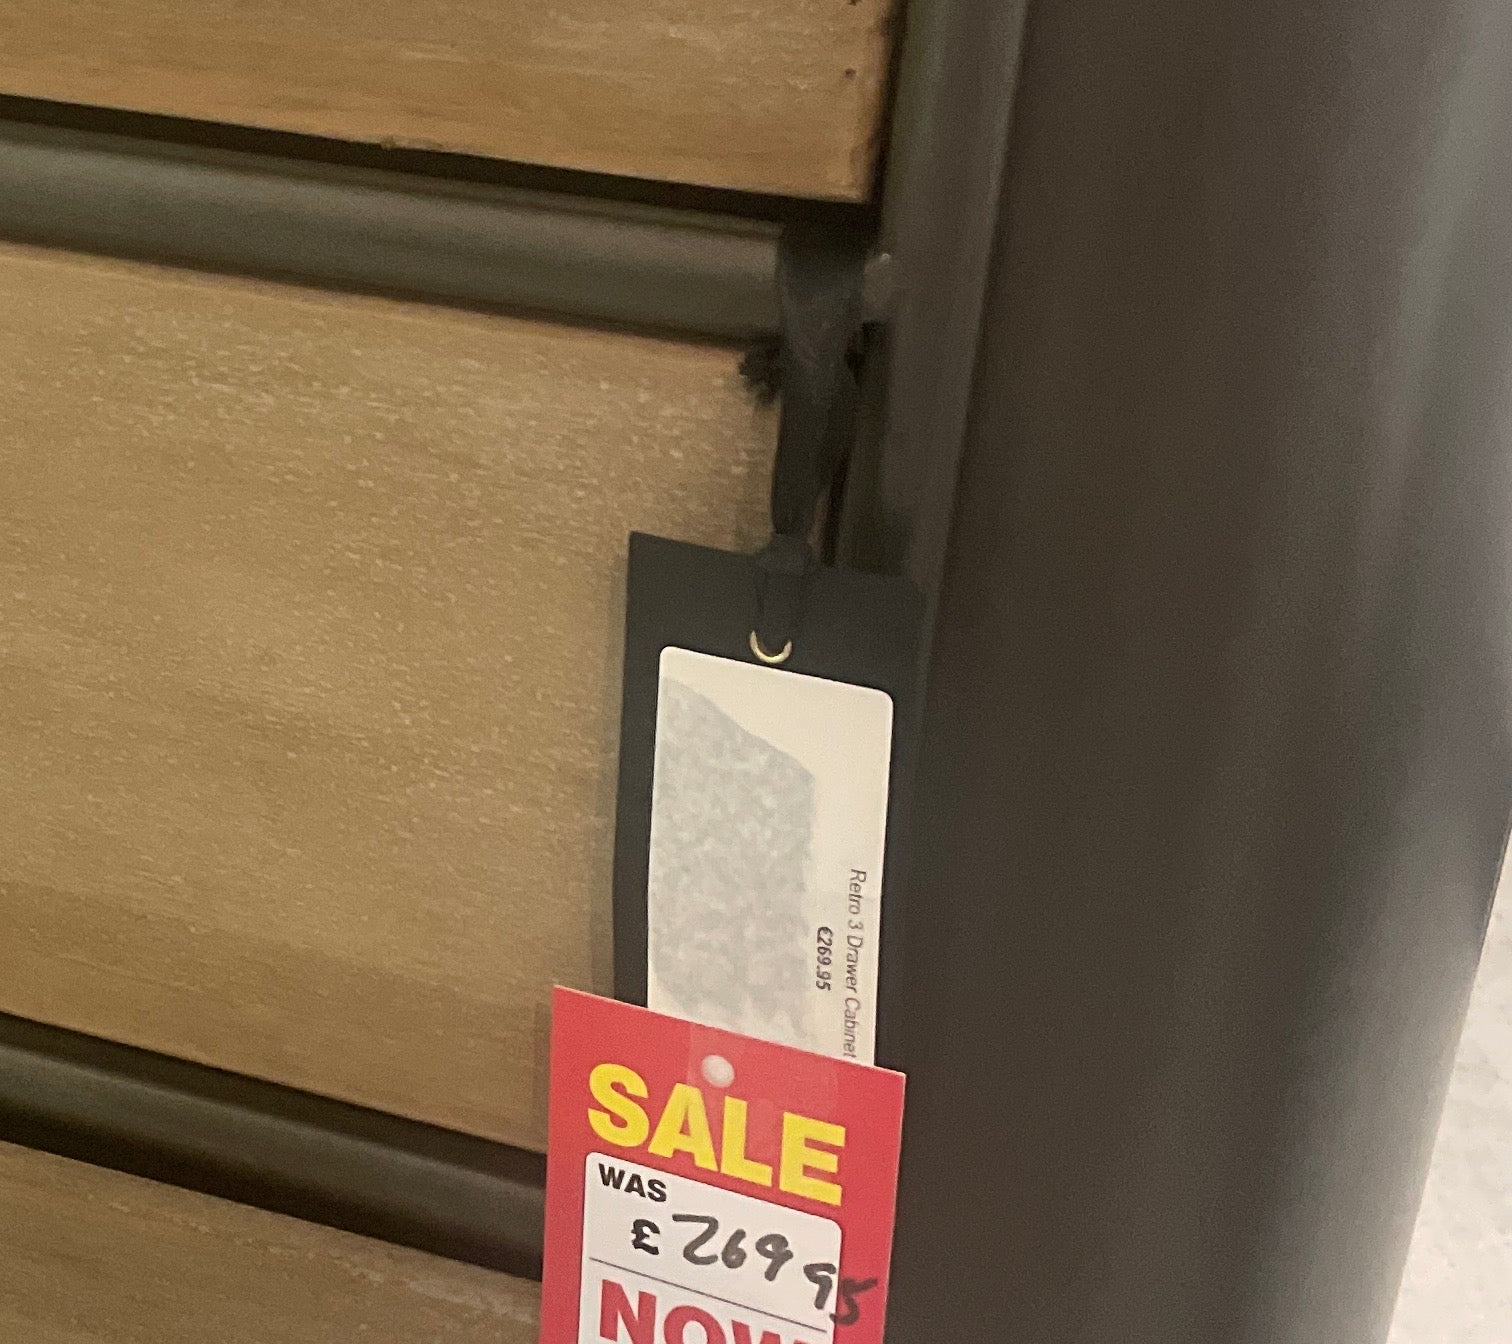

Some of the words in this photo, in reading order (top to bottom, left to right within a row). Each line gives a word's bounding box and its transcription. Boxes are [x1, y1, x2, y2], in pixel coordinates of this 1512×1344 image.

[848, 868, 867, 915] Retro
[847, 919, 864, 930] 3
[845, 935, 864, 994] Drawer
[842, 997, 861, 1058] Cabinet
[588, 1063, 846, 1207] SALE
[598, 1163, 667, 1202] WAS
